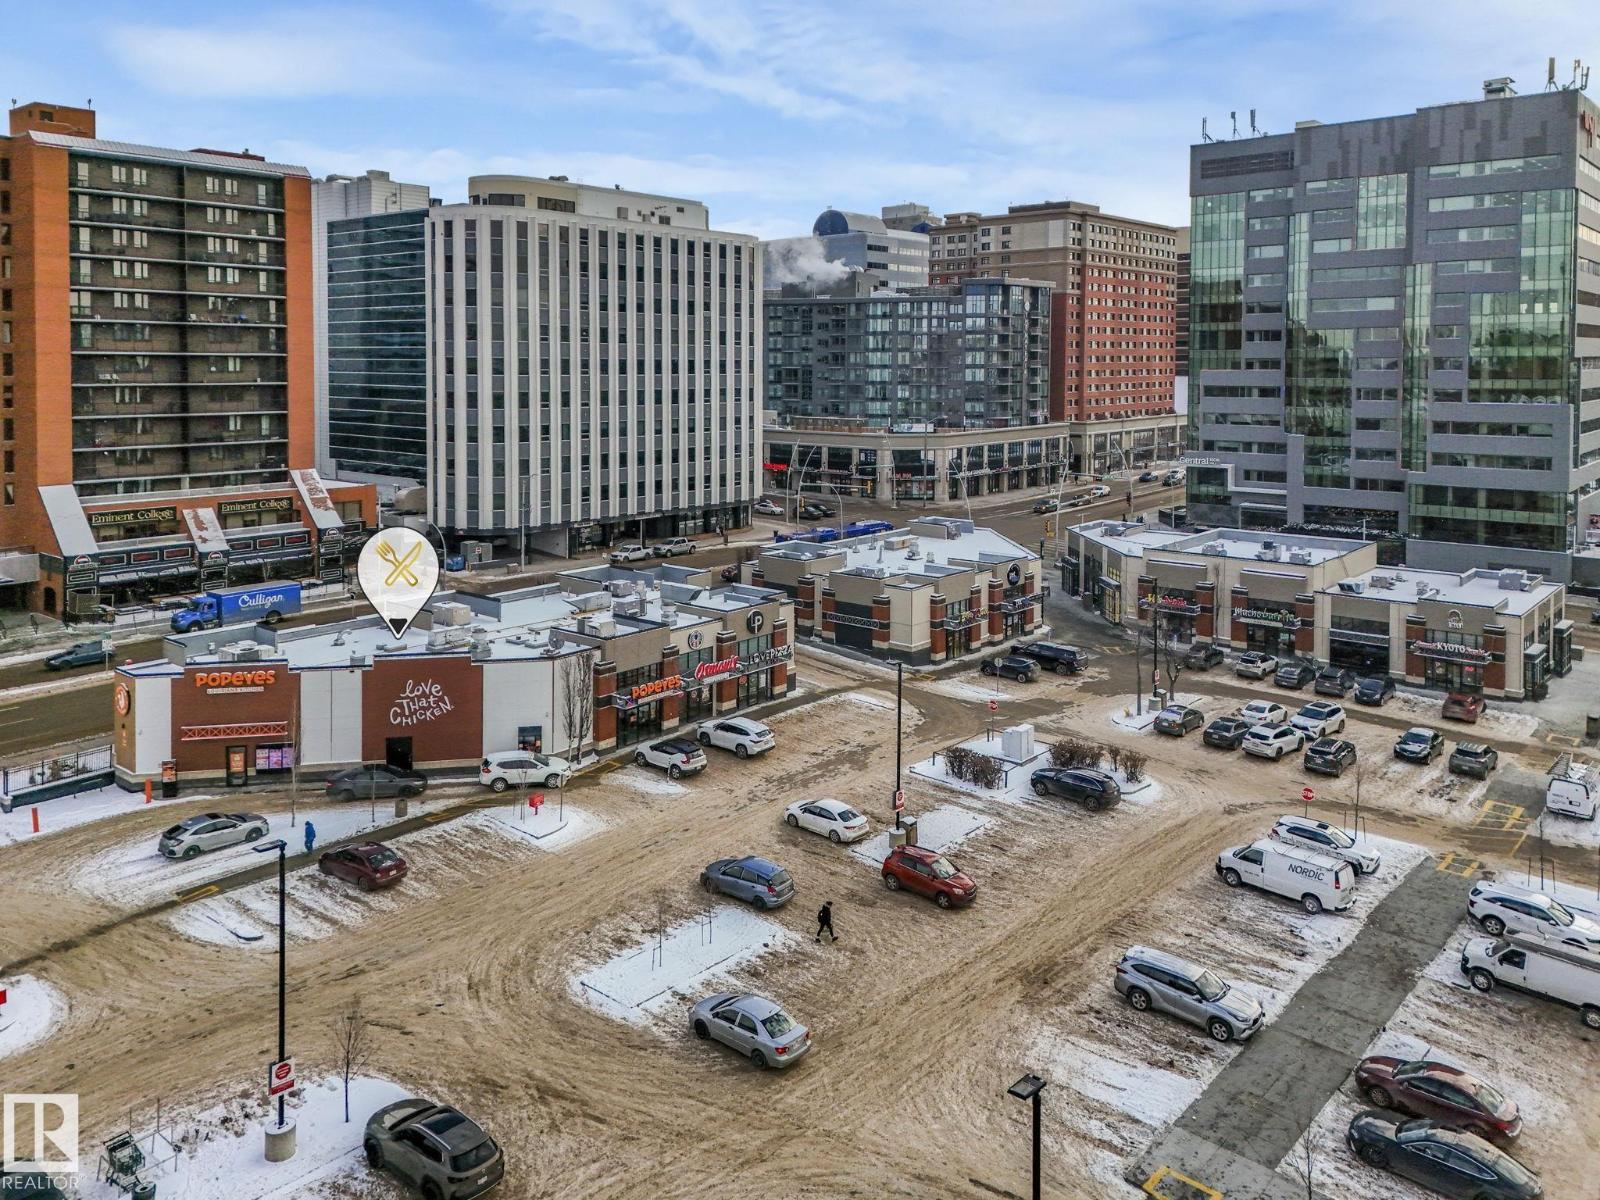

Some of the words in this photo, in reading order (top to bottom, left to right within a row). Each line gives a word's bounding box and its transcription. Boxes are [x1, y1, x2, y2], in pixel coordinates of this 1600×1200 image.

[221, 502, 257, 512] Eminent
[259, 499, 290, 510] College
[92, 513, 133, 524] Eminent
[137, 509, 174, 521] College
[238, 594, 283, 608] Culligan
[1436, 641, 1466, 654] KYOTO
[1288, 864, 1325, 881] NORDIC
